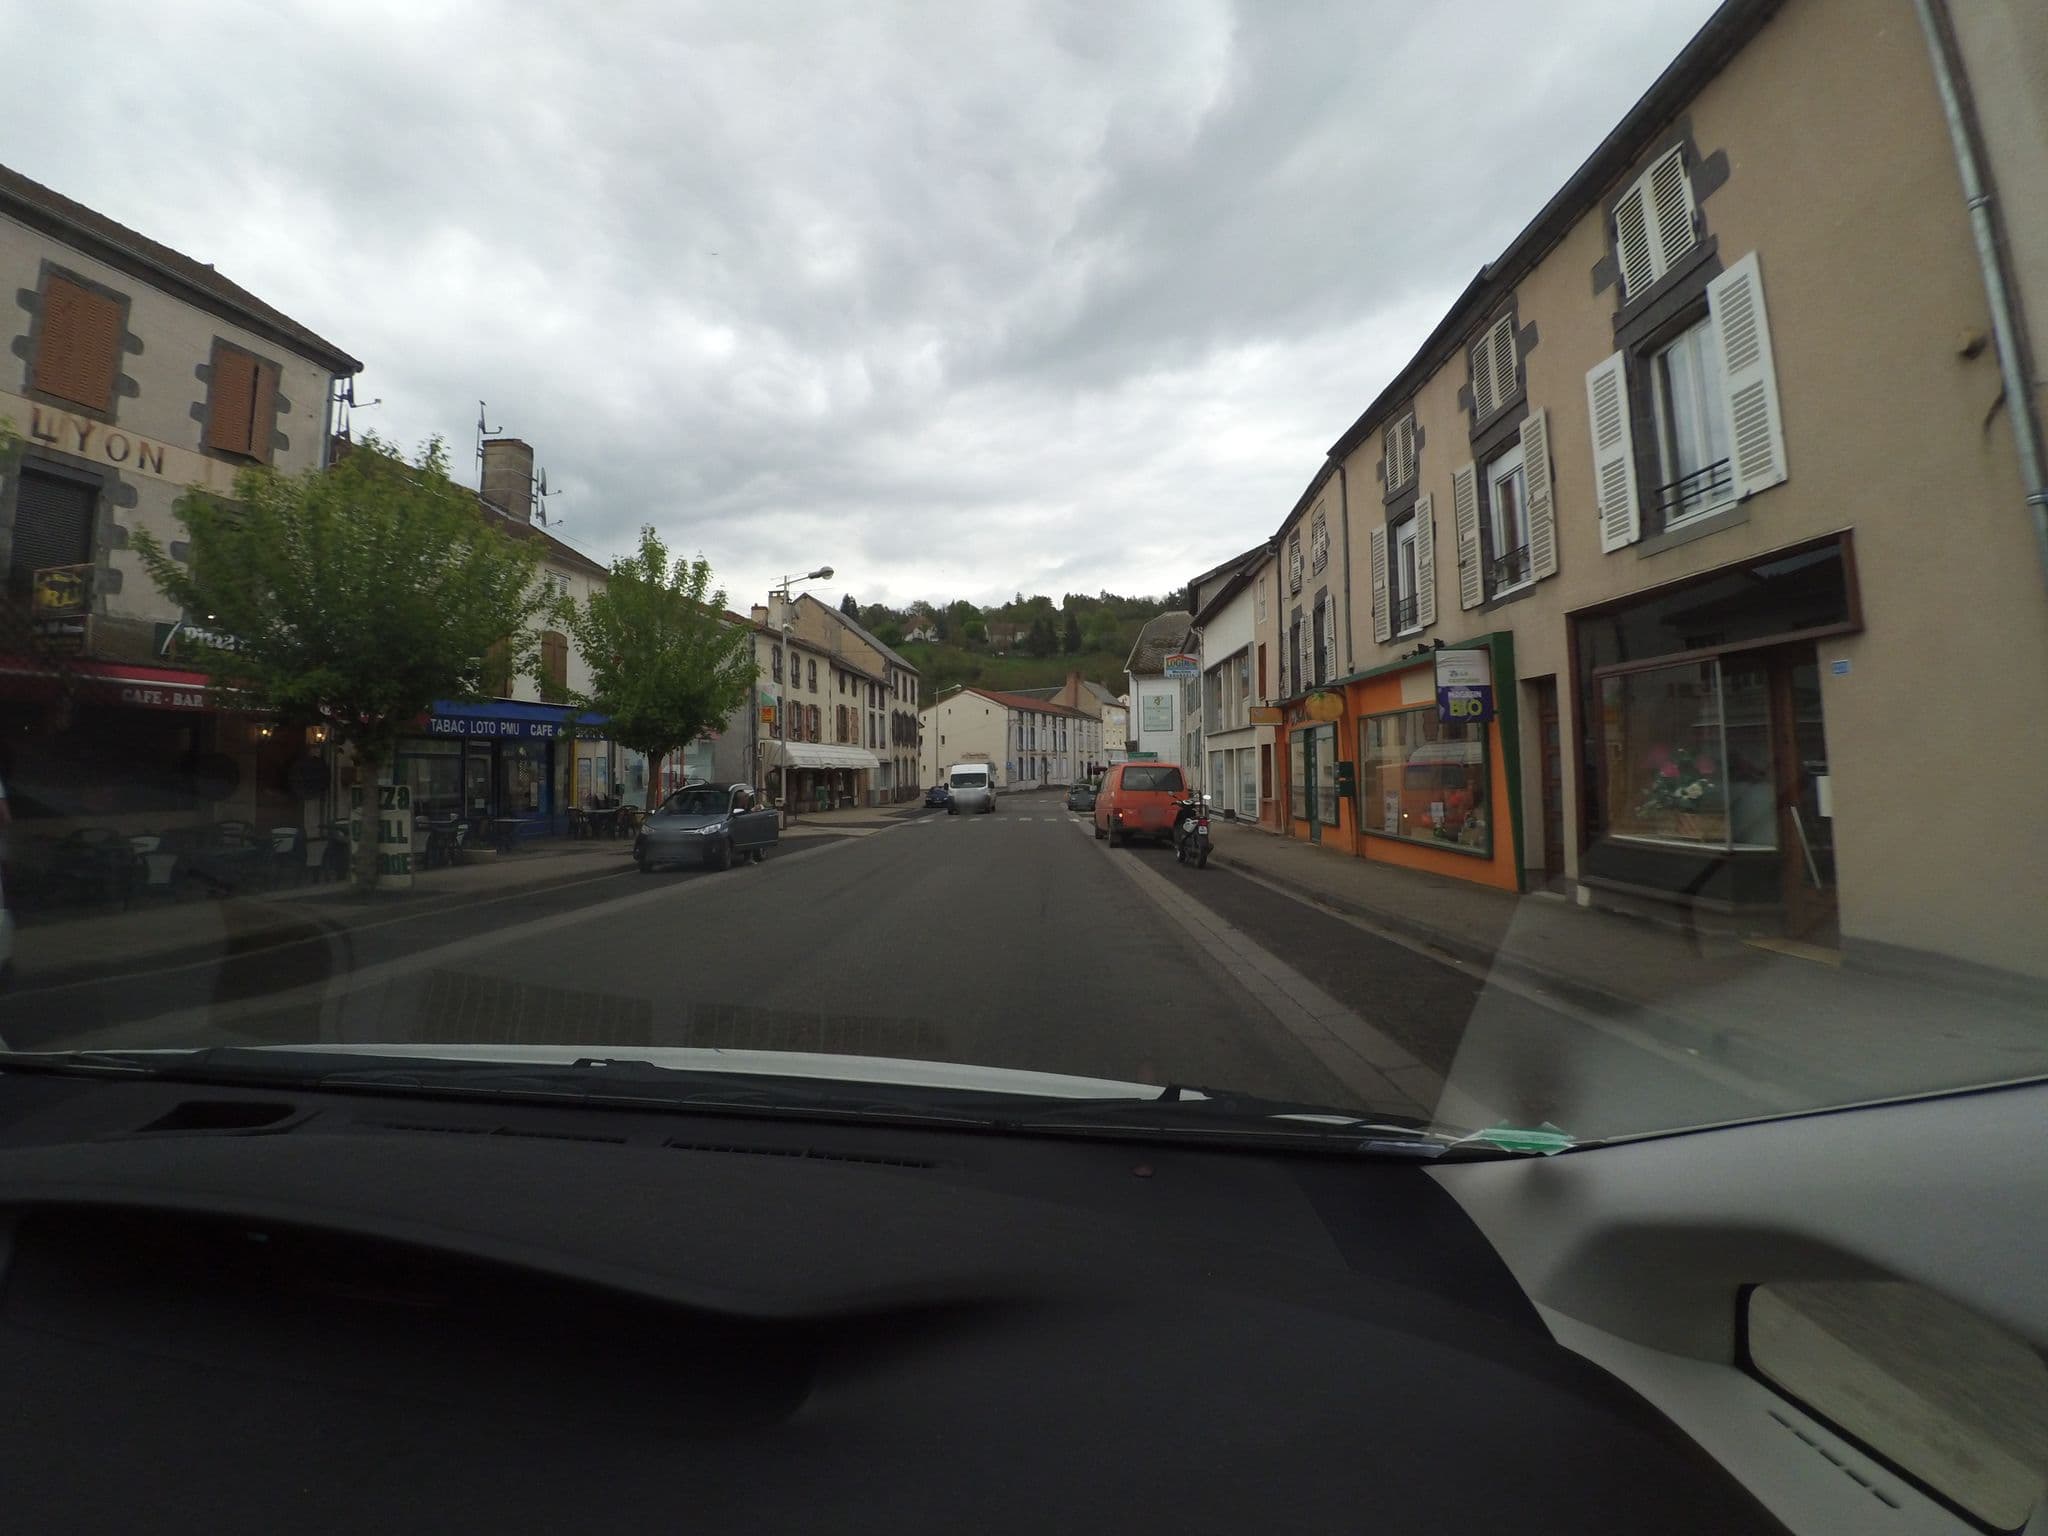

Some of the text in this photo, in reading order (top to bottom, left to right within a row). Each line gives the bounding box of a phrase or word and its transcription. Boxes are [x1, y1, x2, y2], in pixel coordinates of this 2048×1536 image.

[31, 407, 163, 474] LYON
[122, 688, 203, 707] CAFE BAR
[1449, 699, 1483, 717] BIO
[430, 718, 465, 734] TABAC
[470, 720, 496, 734] LOTO
[500, 721, 520, 735] PMU
[530, 724, 553, 736] CAFE
